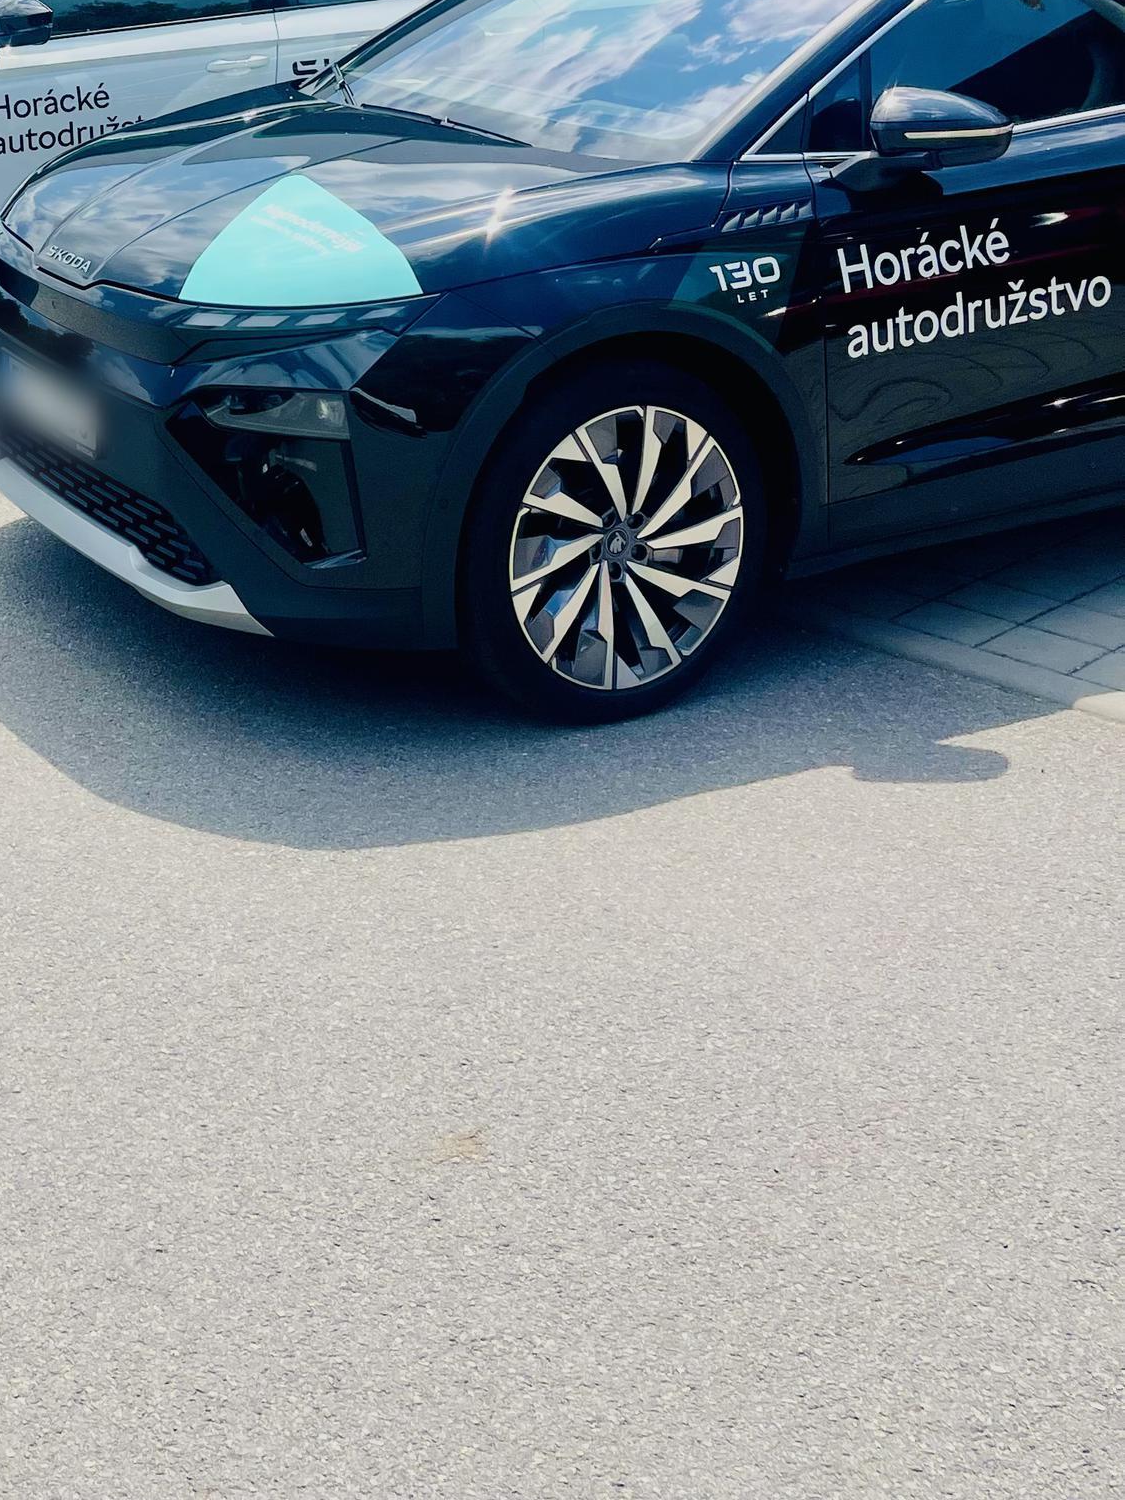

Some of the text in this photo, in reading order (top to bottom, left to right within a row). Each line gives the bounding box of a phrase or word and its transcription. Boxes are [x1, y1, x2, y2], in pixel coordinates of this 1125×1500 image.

[708, 256, 781, 292] 130
[836, 217, 1011, 294] Horácké
[736, 288, 769, 304] LET
[847, 275, 1112, 359] autodružstvo
